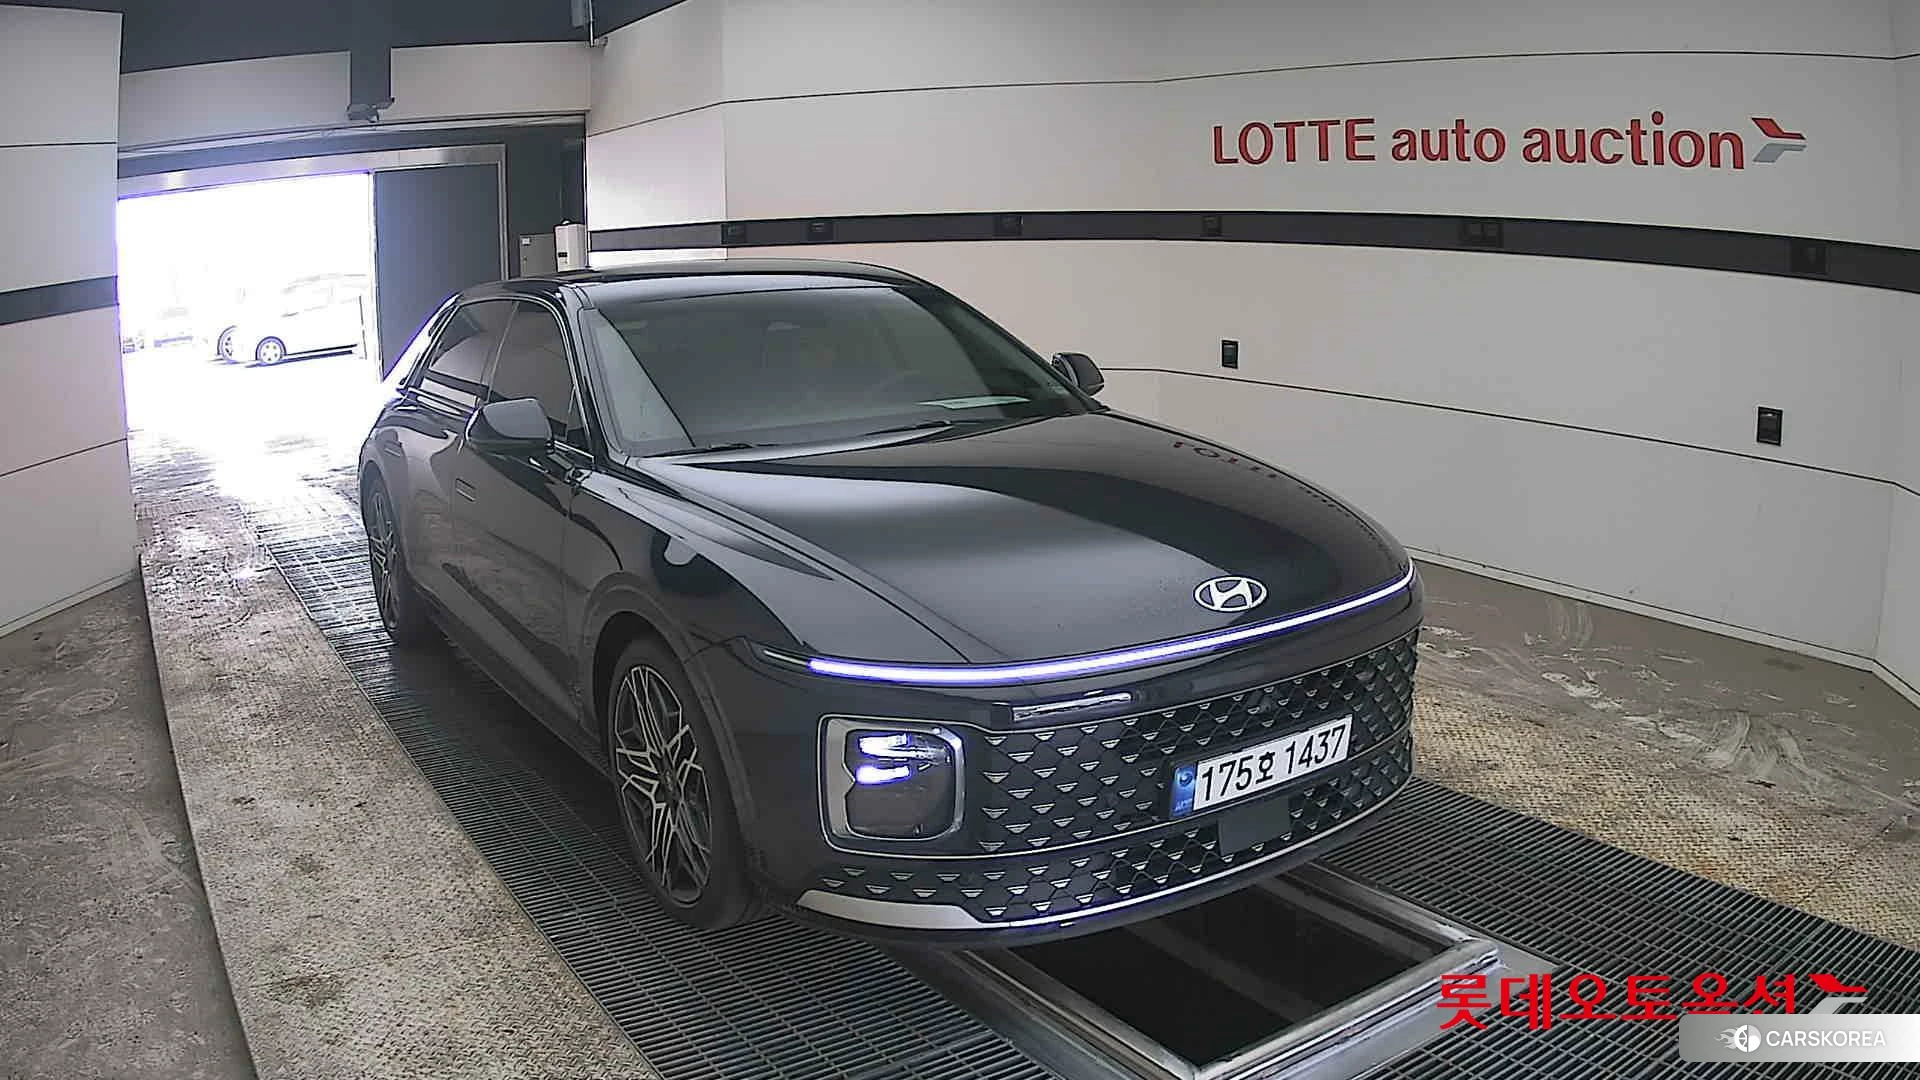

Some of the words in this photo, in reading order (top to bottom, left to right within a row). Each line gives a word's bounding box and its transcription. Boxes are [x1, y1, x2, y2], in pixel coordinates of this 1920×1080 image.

[1212, 117, 1376, 165] LOTTE
[1390, 118, 1507, 163] auto
[1521, 110, 1745, 170] auction
[1201, 751, 1276, 802] 175호
[1285, 724, 1346, 775] 1437
